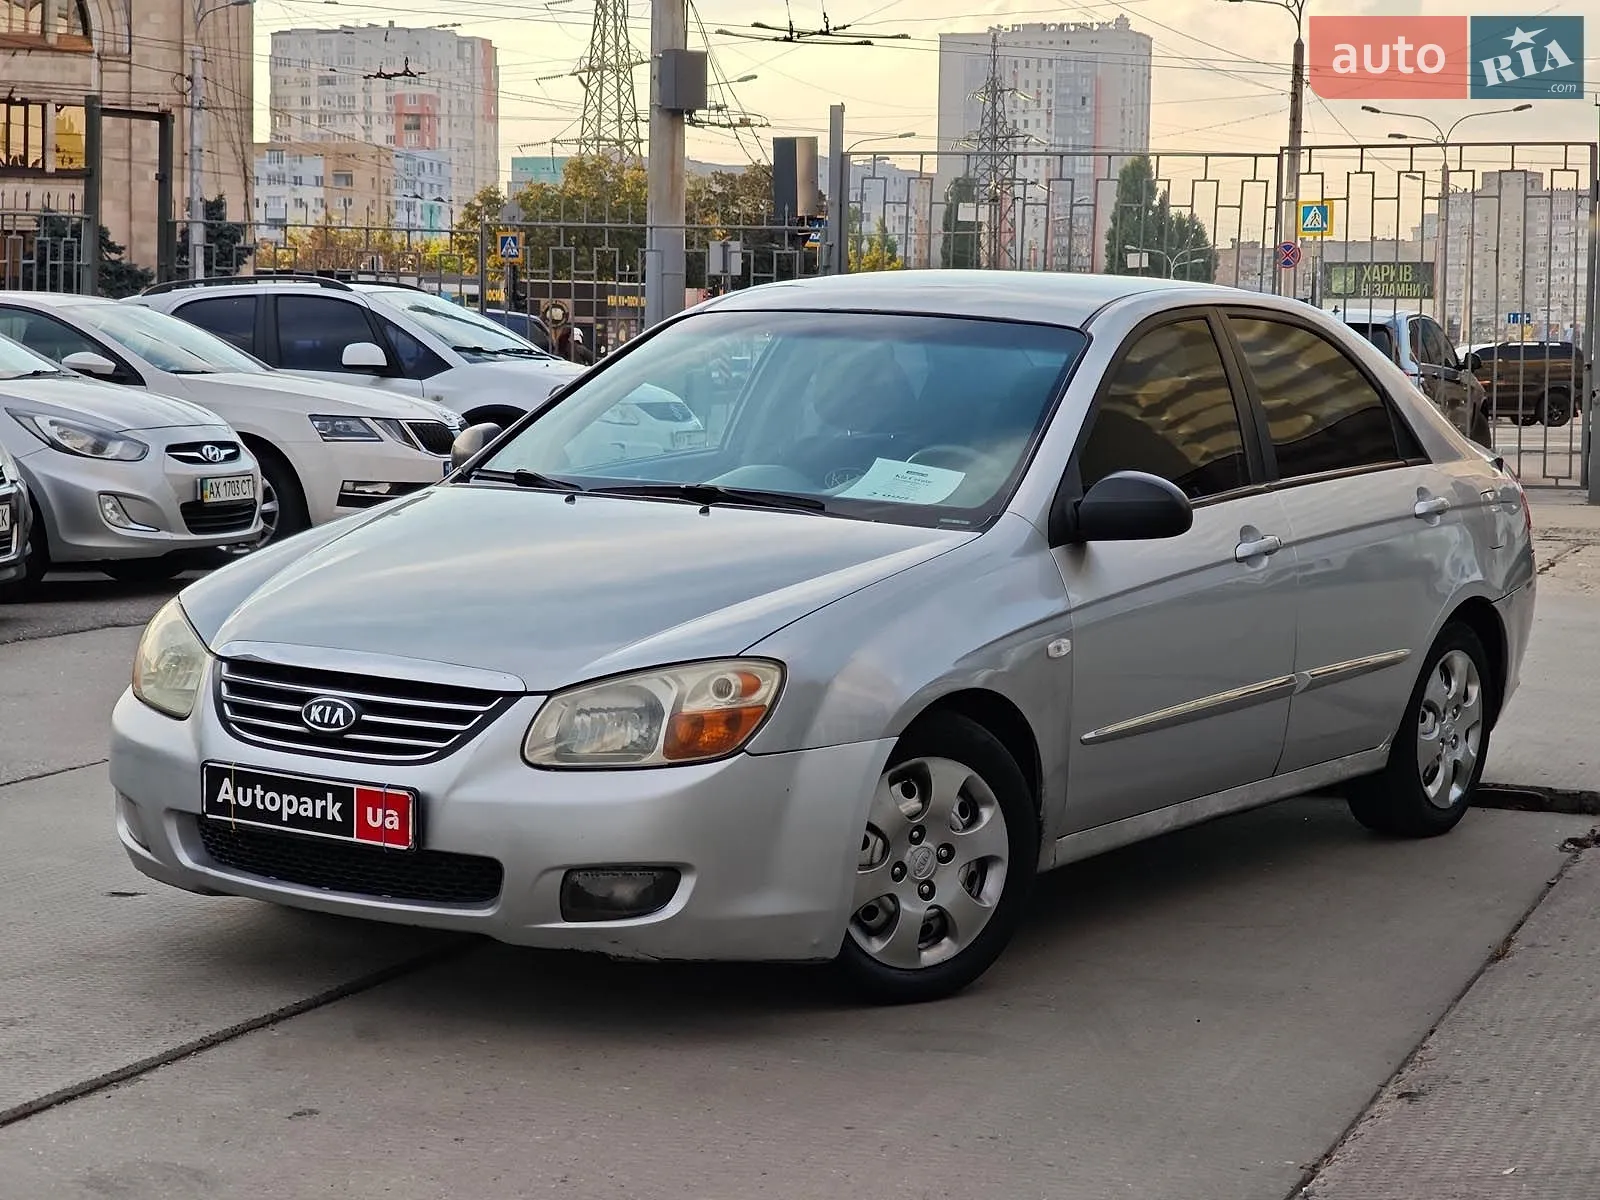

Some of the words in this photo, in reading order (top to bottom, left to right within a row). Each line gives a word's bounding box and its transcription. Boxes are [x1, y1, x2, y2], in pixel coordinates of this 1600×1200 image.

[1362, 264, 1413, 282] ХАРКІВ
[209, 481, 221, 498] AX
[222, 480, 240, 497] 1703
[241, 479, 252, 496] CT
[0, 508, 8, 527] K
[310, 704, 345, 726] KIA
[216, 777, 343, 822] Autopark
[366, 805, 400, 830] ua
